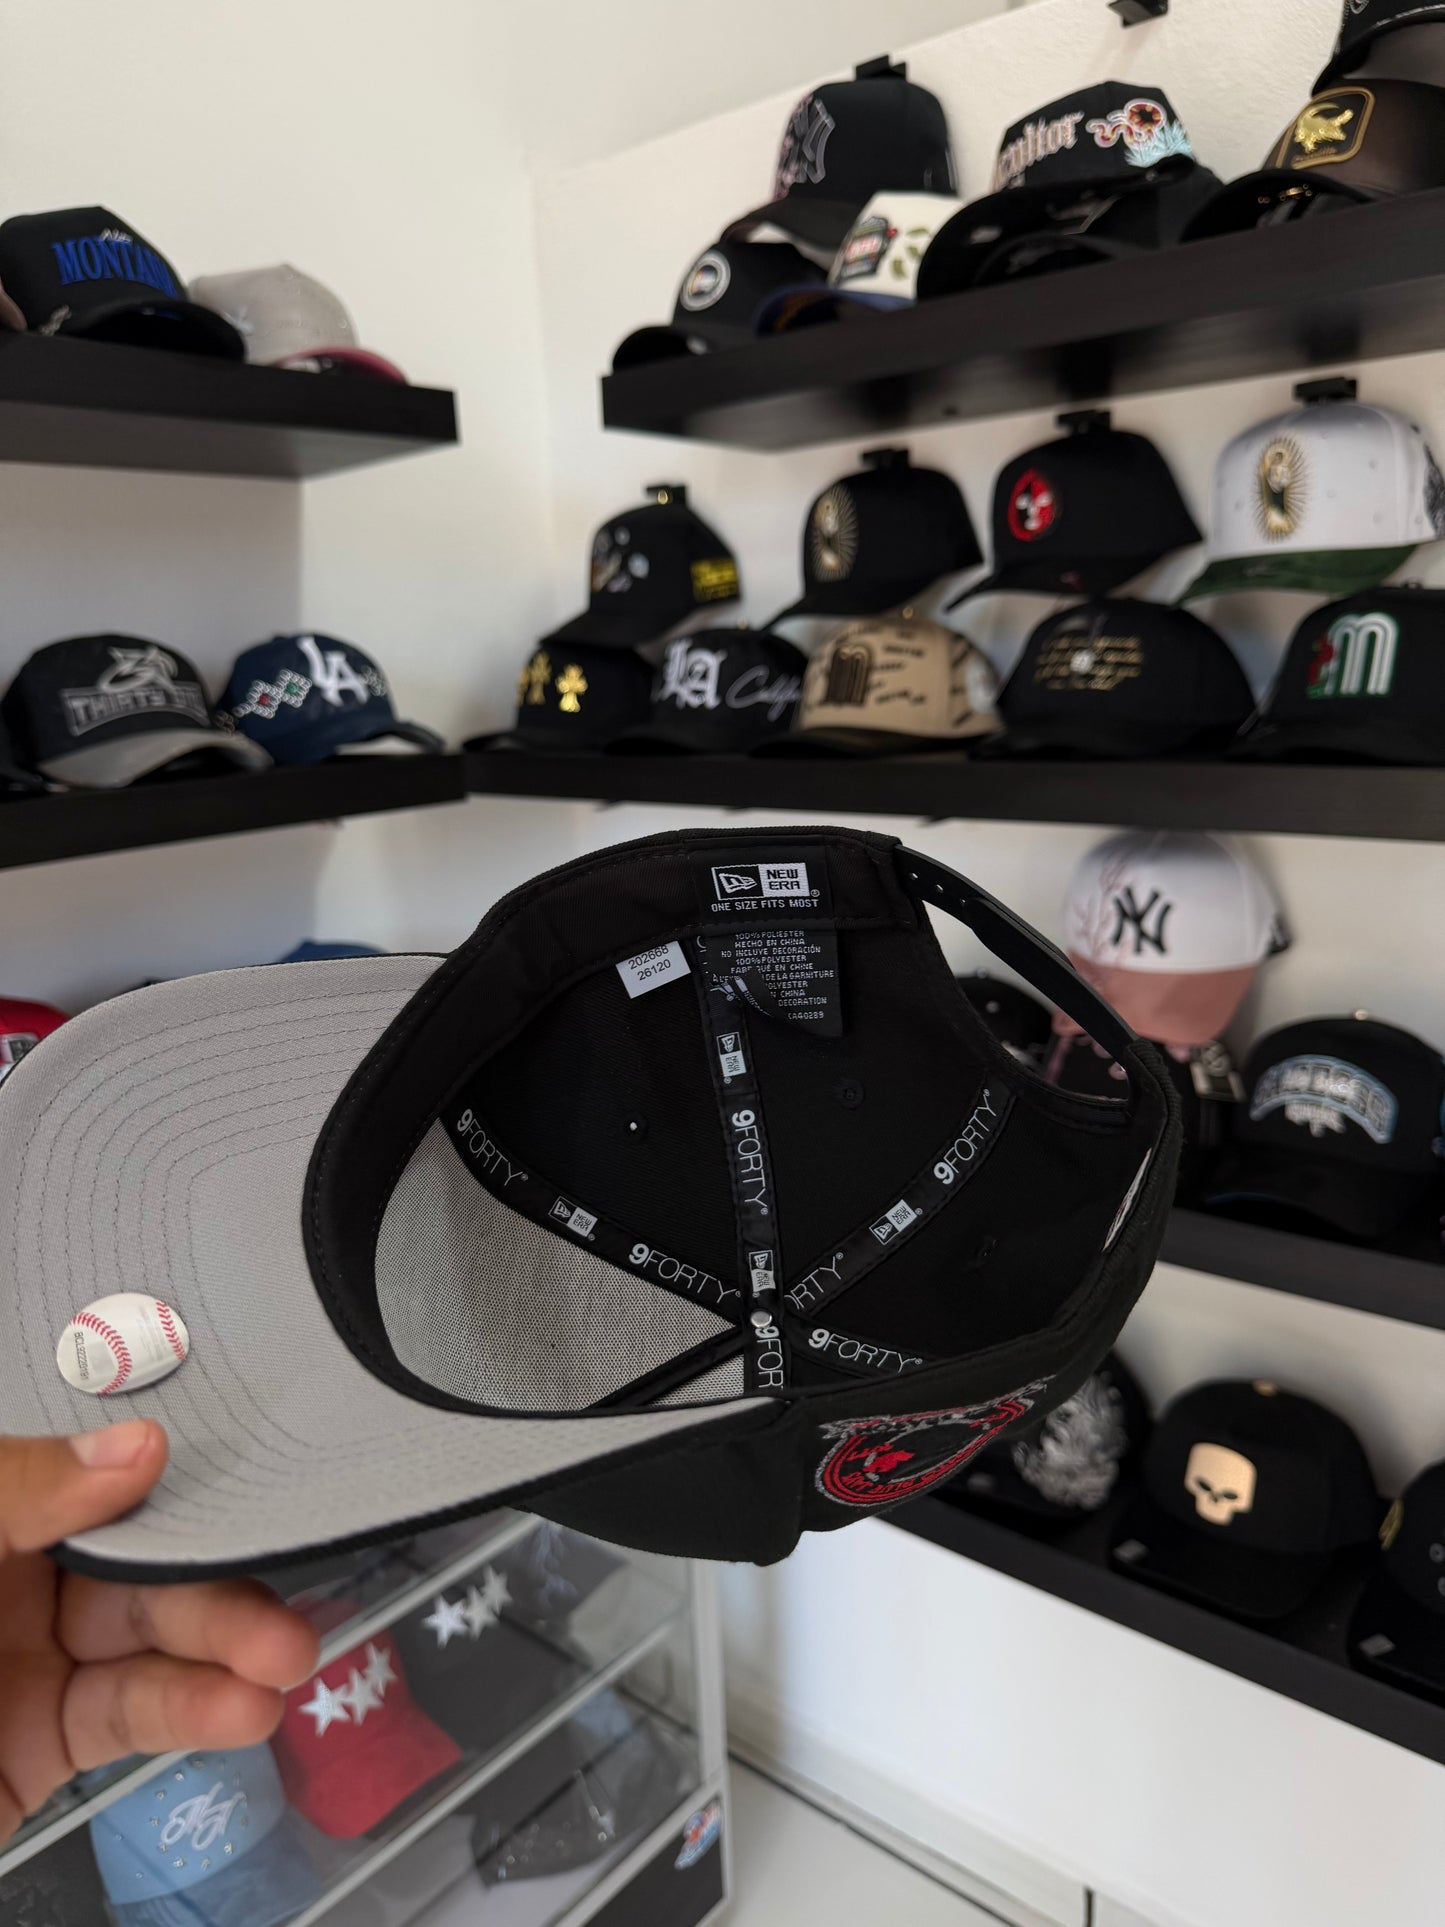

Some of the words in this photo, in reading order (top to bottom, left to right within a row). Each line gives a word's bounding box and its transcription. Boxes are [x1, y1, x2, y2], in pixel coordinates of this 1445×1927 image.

[297, 636, 369, 706] LA
[767, 869, 798, 880] NEW
[769, 881, 800, 891] ERA
[711, 902, 731, 912] ONE
[735, 901, 758, 911] SIZE
[761, 900, 785, 909] FITS
[789, 899, 819, 908] MOST
[1111, 887, 1172, 955] NY
[721, 950, 732, 958] NO
[735, 948, 768, 957] INCLUYE
[772, 944, 821, 955] DECORACIÓN
[734, 940, 763, 948] HECHO
[766, 939, 777, 947] EN
[780, 938, 805, 946] CHINA
[628, 945, 669, 969] 202668
[775, 964, 786, 972] EN
[790, 963, 813, 971] CHINE
[637, 959, 671, 980] 26120
[766, 981, 808, 989] OLYESTER
[780, 989, 806, 997] CHINA
[778, 997, 828, 1007] DECORATION
[457, 1108, 524, 1187] 9FORTY
[933, 1094, 997, 1185] 9FORTY
[732, 1109, 768, 1207] 9FORTY
[628, 1243, 737, 1304] 9FORTY
[754, 1325, 784, 1389] 9FOR
[808, 1328, 917, 1373] 9FORTY
